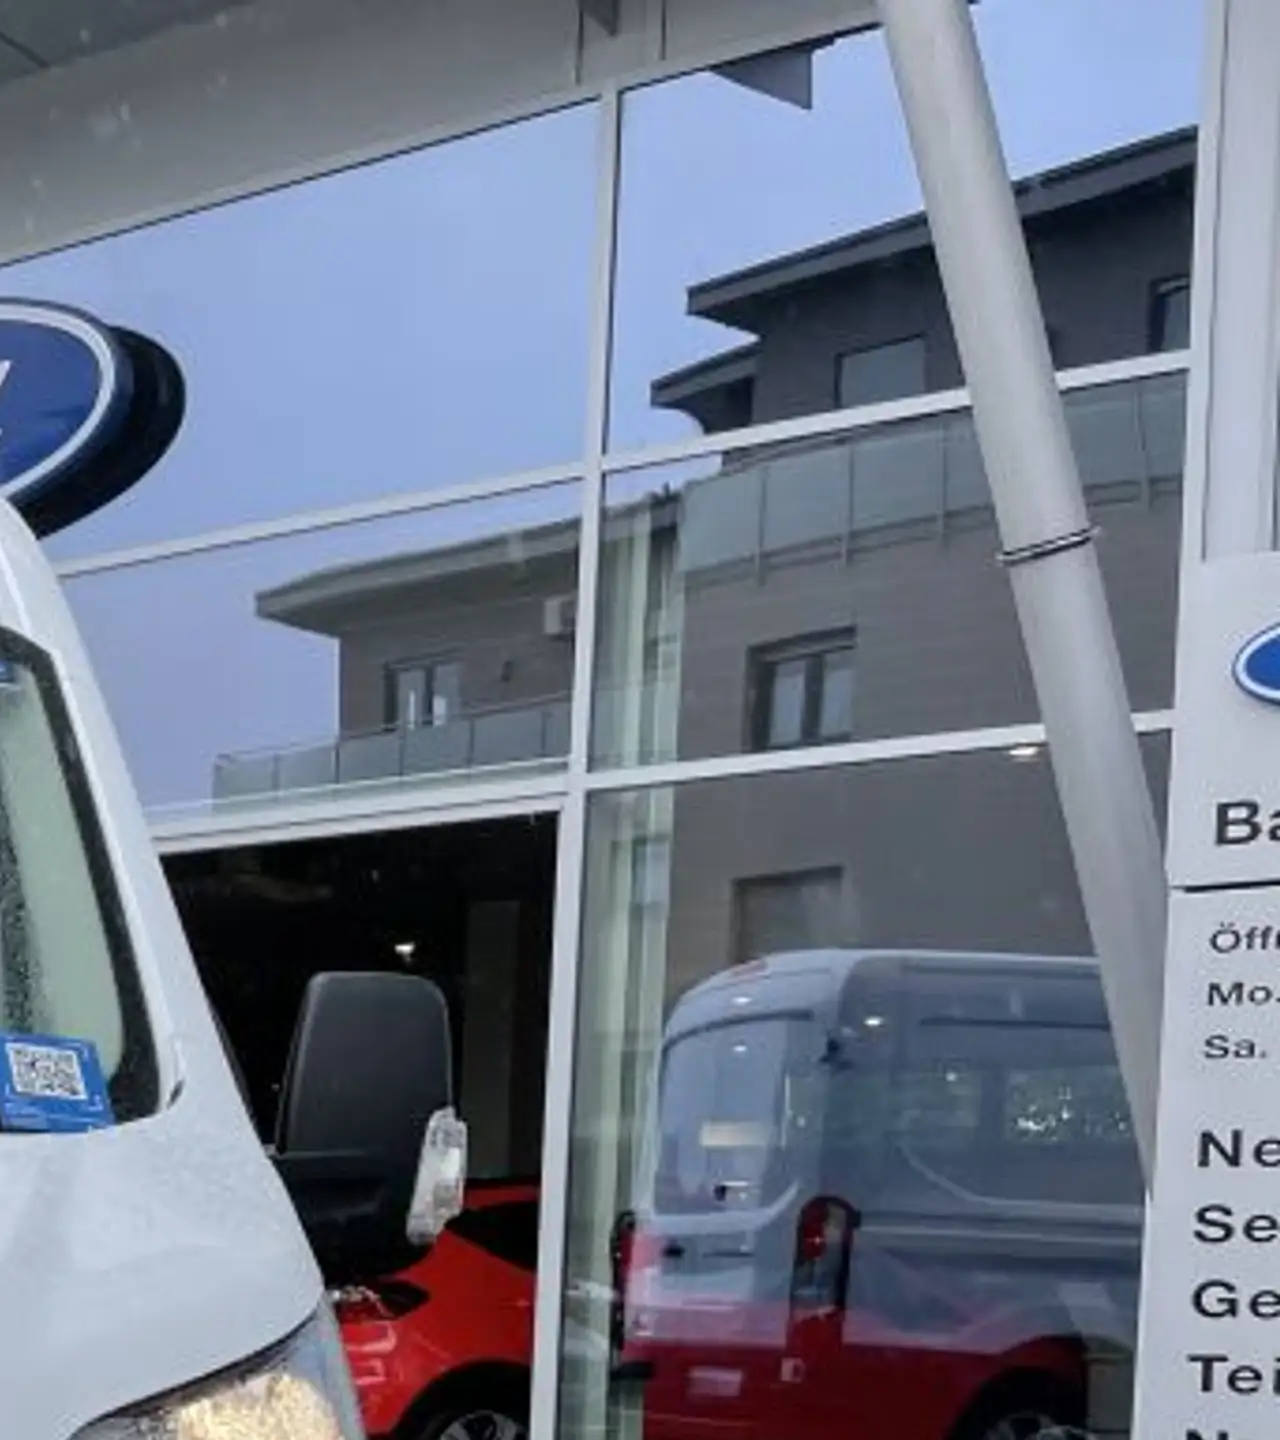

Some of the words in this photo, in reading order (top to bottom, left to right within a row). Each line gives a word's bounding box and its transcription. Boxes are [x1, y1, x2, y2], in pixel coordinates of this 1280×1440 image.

[1204, 1034, 1267, 1059] Sa.
[1194, 1204, 1279, 1243] Se
[1192, 1279, 1280, 1319] Ge
